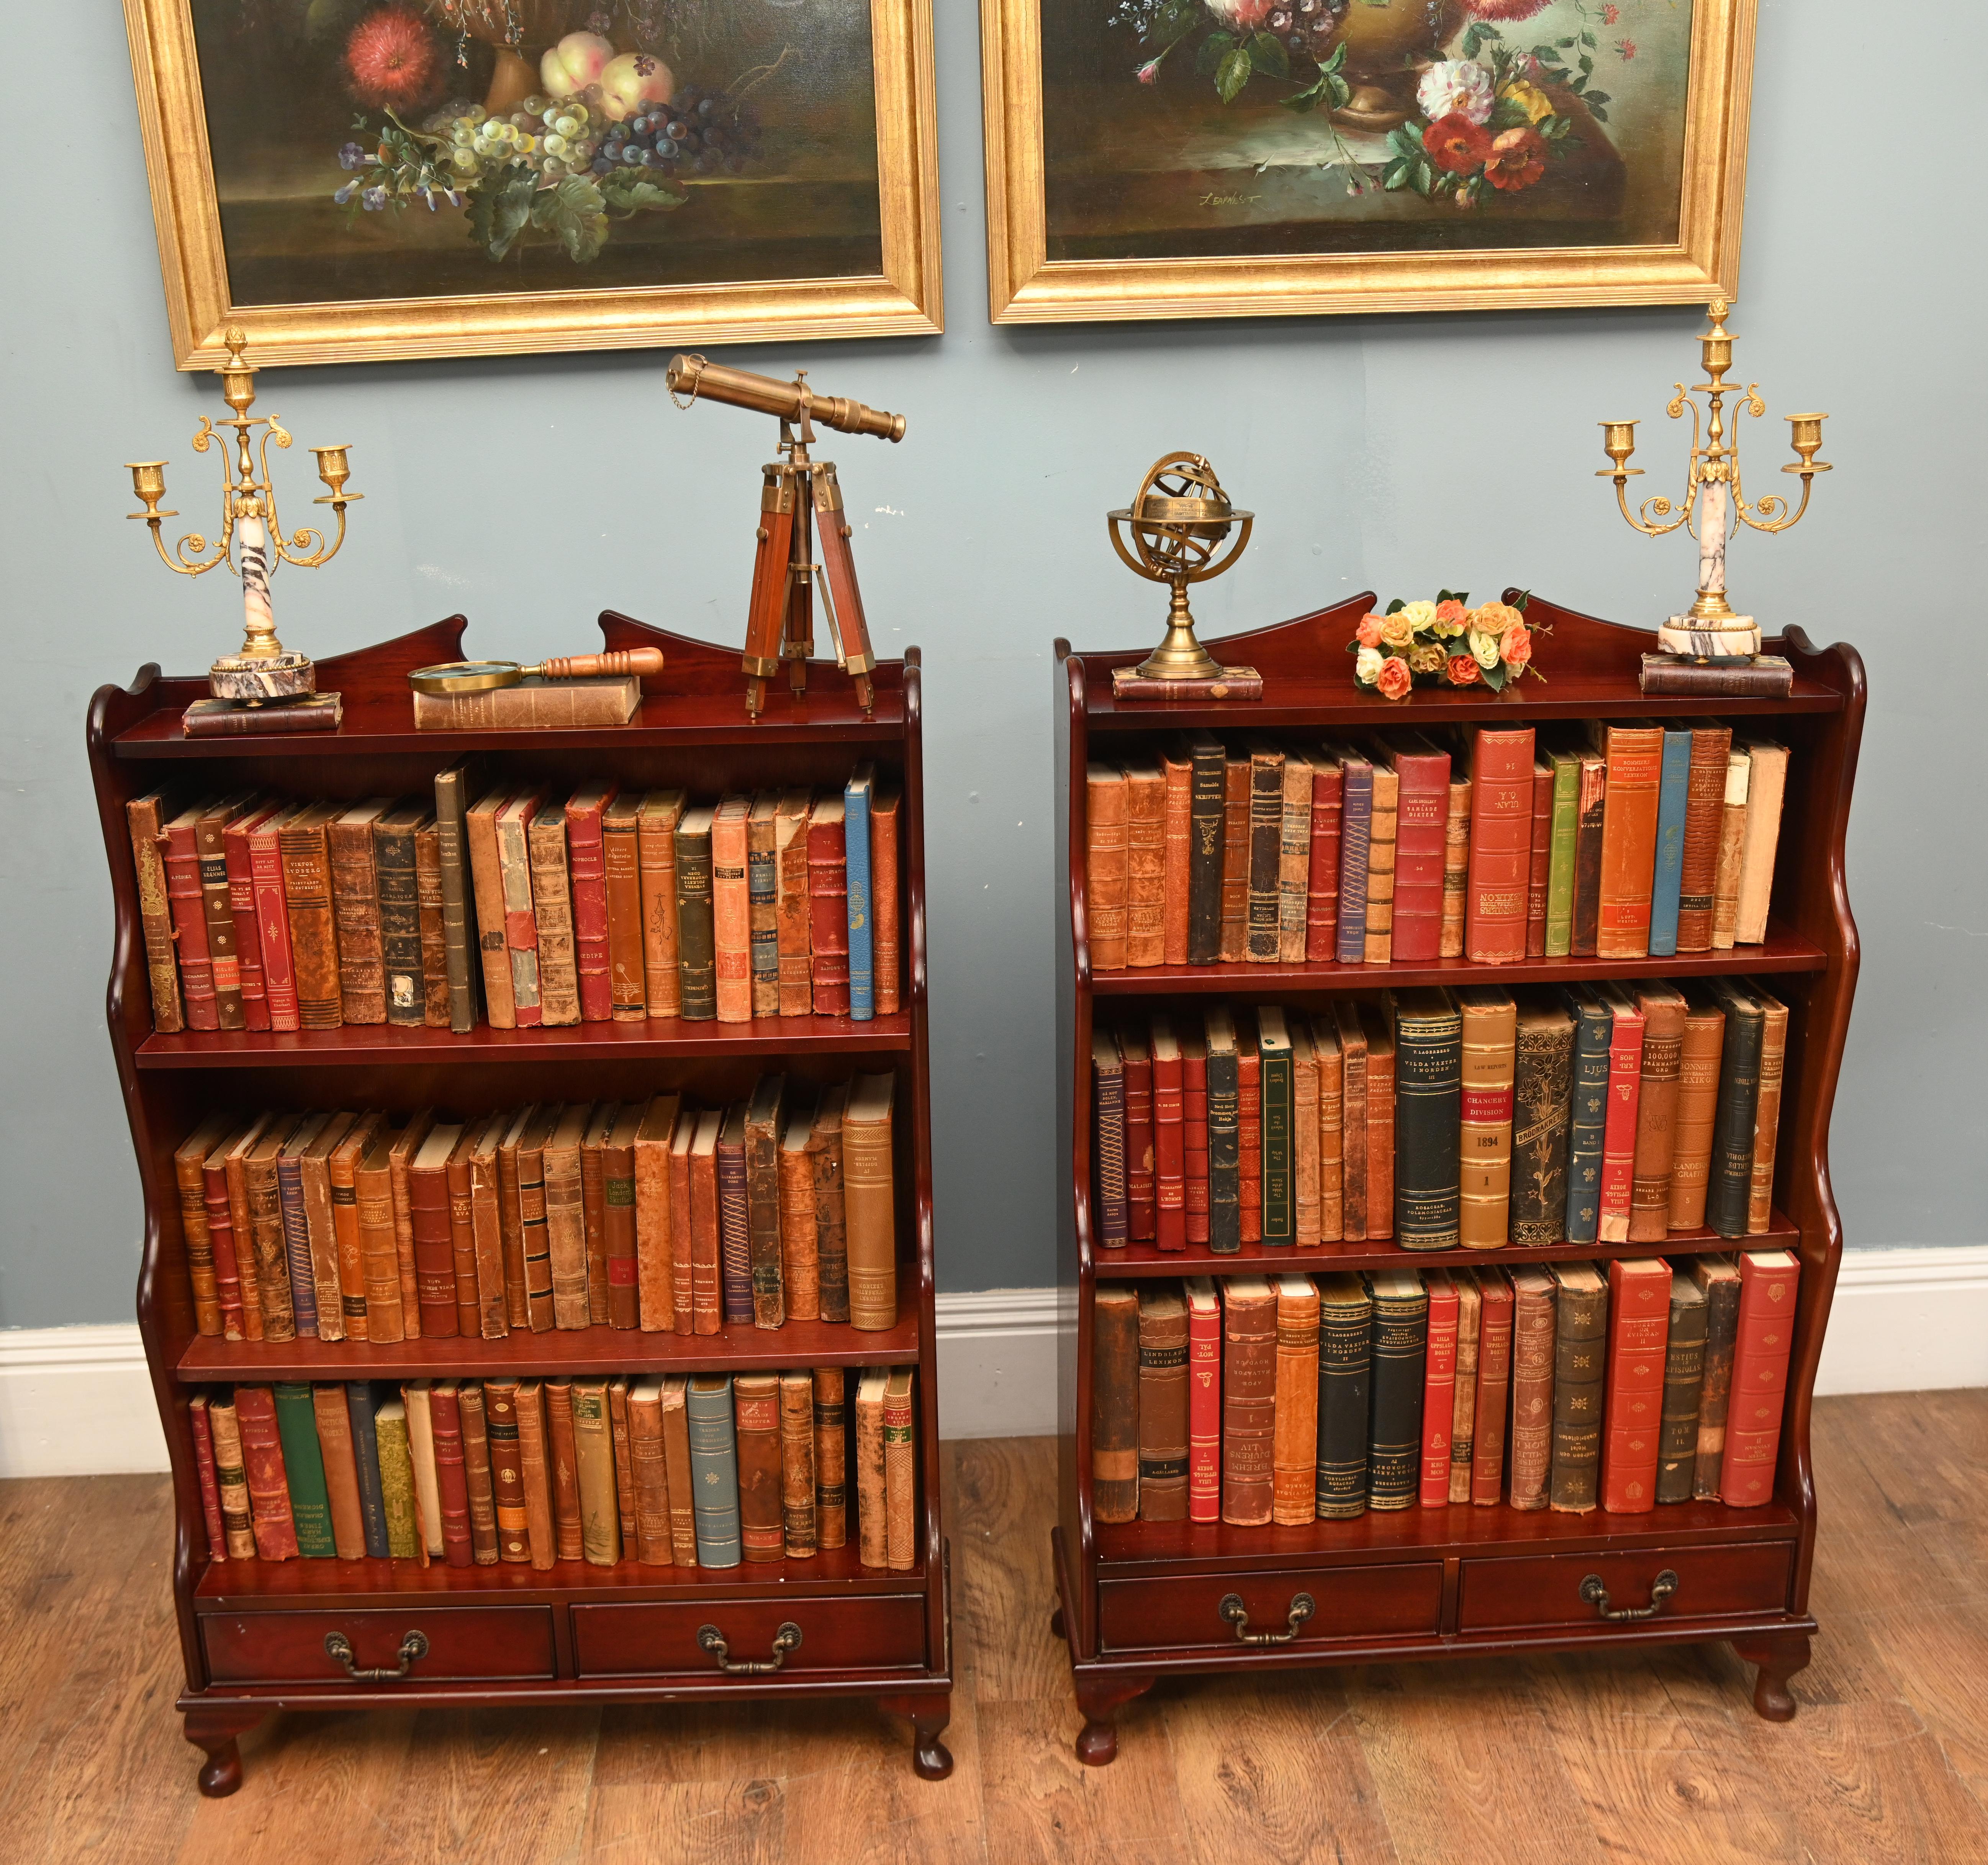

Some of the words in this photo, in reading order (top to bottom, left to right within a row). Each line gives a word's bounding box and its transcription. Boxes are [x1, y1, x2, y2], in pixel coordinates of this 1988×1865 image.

[1648, 1052, 1677, 1060] 100,000
[1584, 1065, 1608, 1074] LJUS
[1477, 1136, 1498, 1148] 1894
[1484, 1176, 1489, 1186] 1
[1670, 1352, 1698, 1361] ESTIUS
[1230, 1451, 1271, 1459] DJURENS
[1232, 1462, 1267, 1471] BREHM
